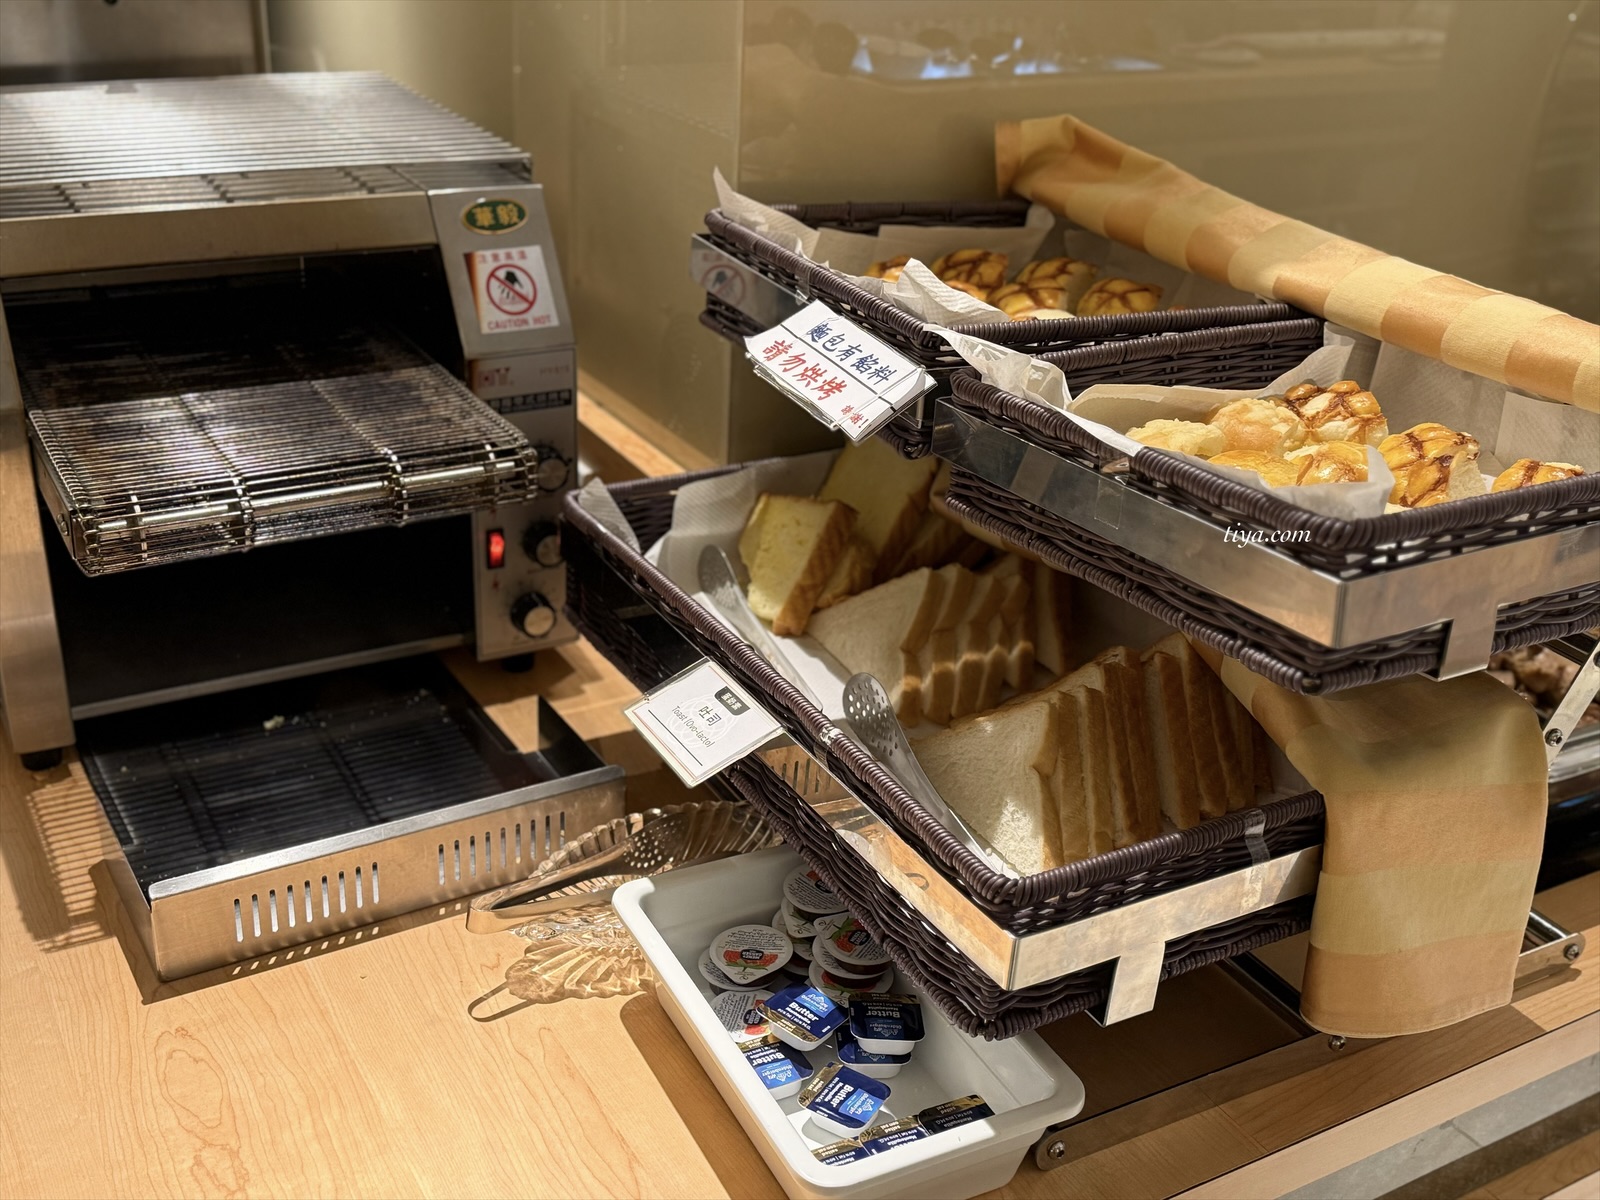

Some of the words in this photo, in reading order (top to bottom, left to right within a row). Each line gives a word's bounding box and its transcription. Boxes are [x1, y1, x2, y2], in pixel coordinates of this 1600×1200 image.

[487, 317, 529, 330] CAUTION
[532, 314, 552, 325] HOT
[762, 338, 848, 401] 請勿烘烤
[697, 704, 722, 727] 吐司
[671, 705, 688, 724] Toast
[683, 718, 716, 748] (Ovo-lacto)
[787, 1000, 819, 1021] Butter
[865, 1009, 900, 1018] Butter
[751, 1051, 785, 1066] Butter
[829, 1083, 854, 1108] Butter
[883, 1124, 901, 1133] salted
[821, 1148, 838, 1156] salted
